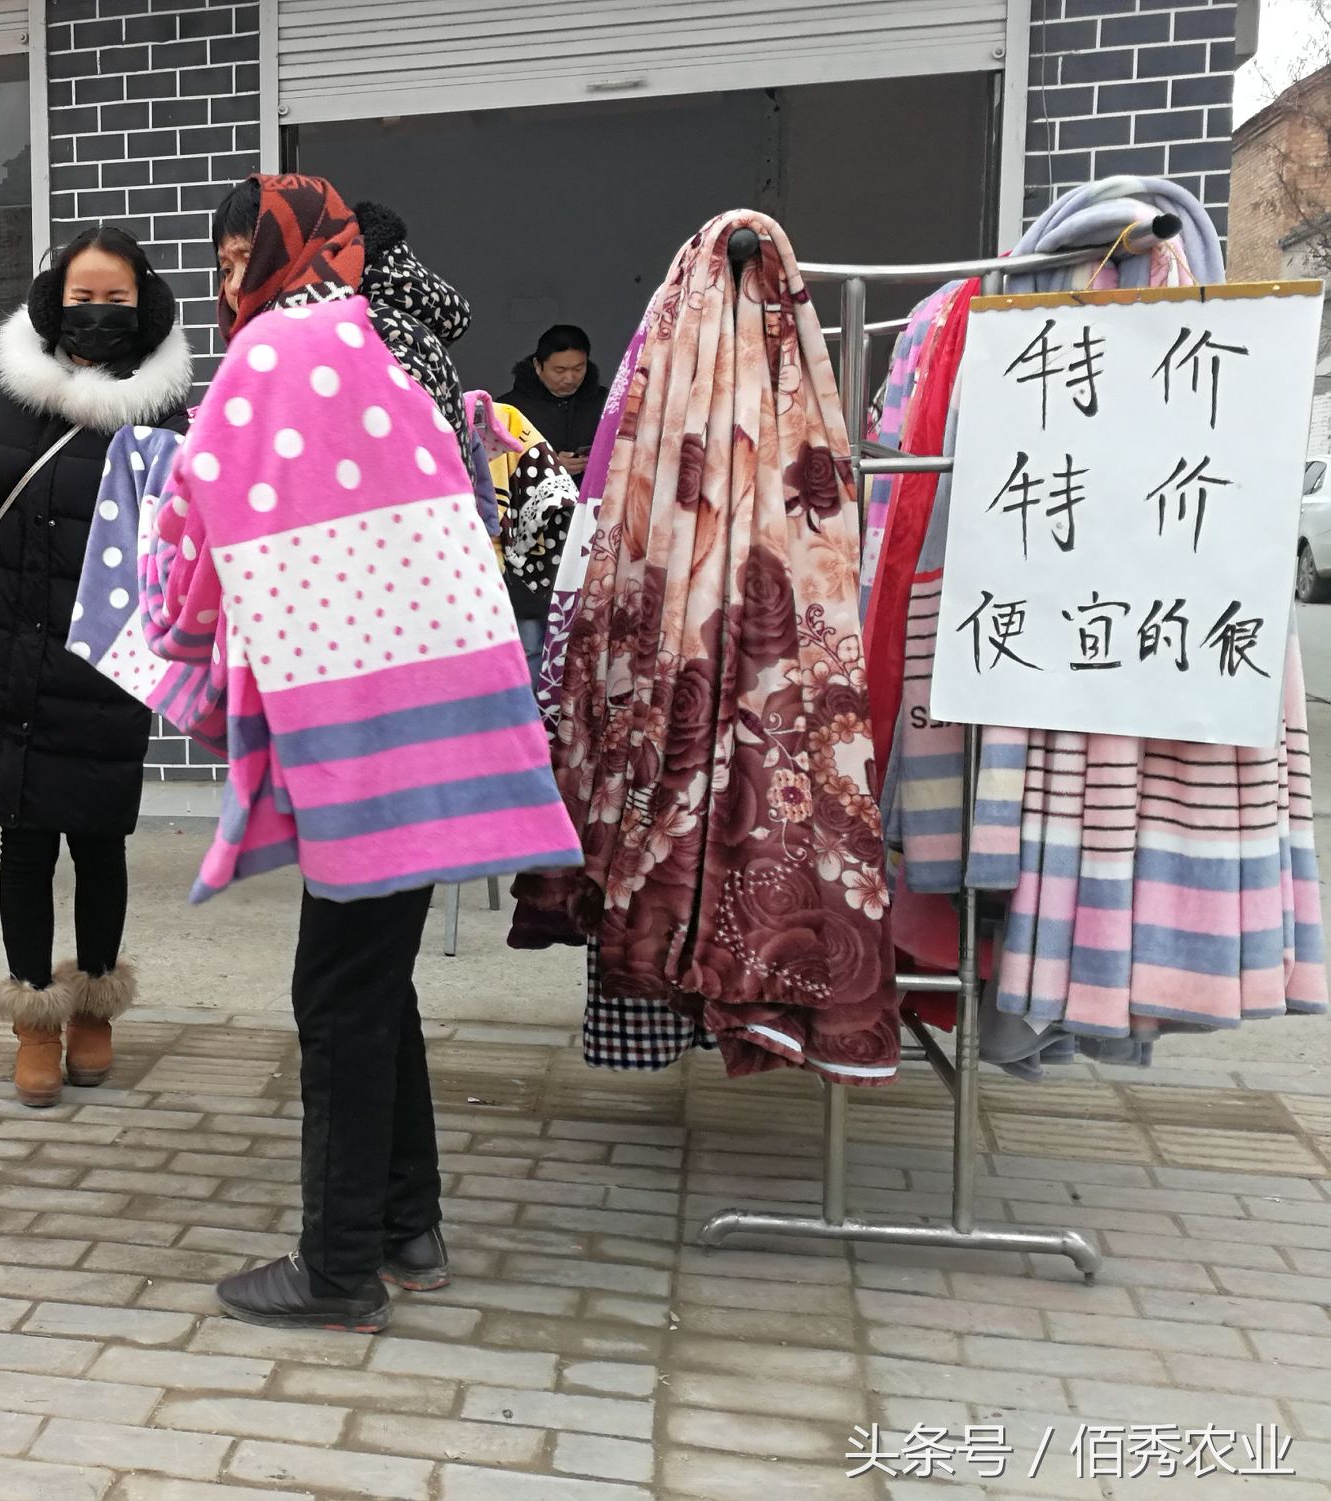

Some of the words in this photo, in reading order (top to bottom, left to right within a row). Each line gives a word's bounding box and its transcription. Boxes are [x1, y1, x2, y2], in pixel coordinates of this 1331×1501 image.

[1003, 318, 1250, 431] 特价
[986, 450, 1234, 560] 特价
[955, 590, 1272, 680] 便宜的很
